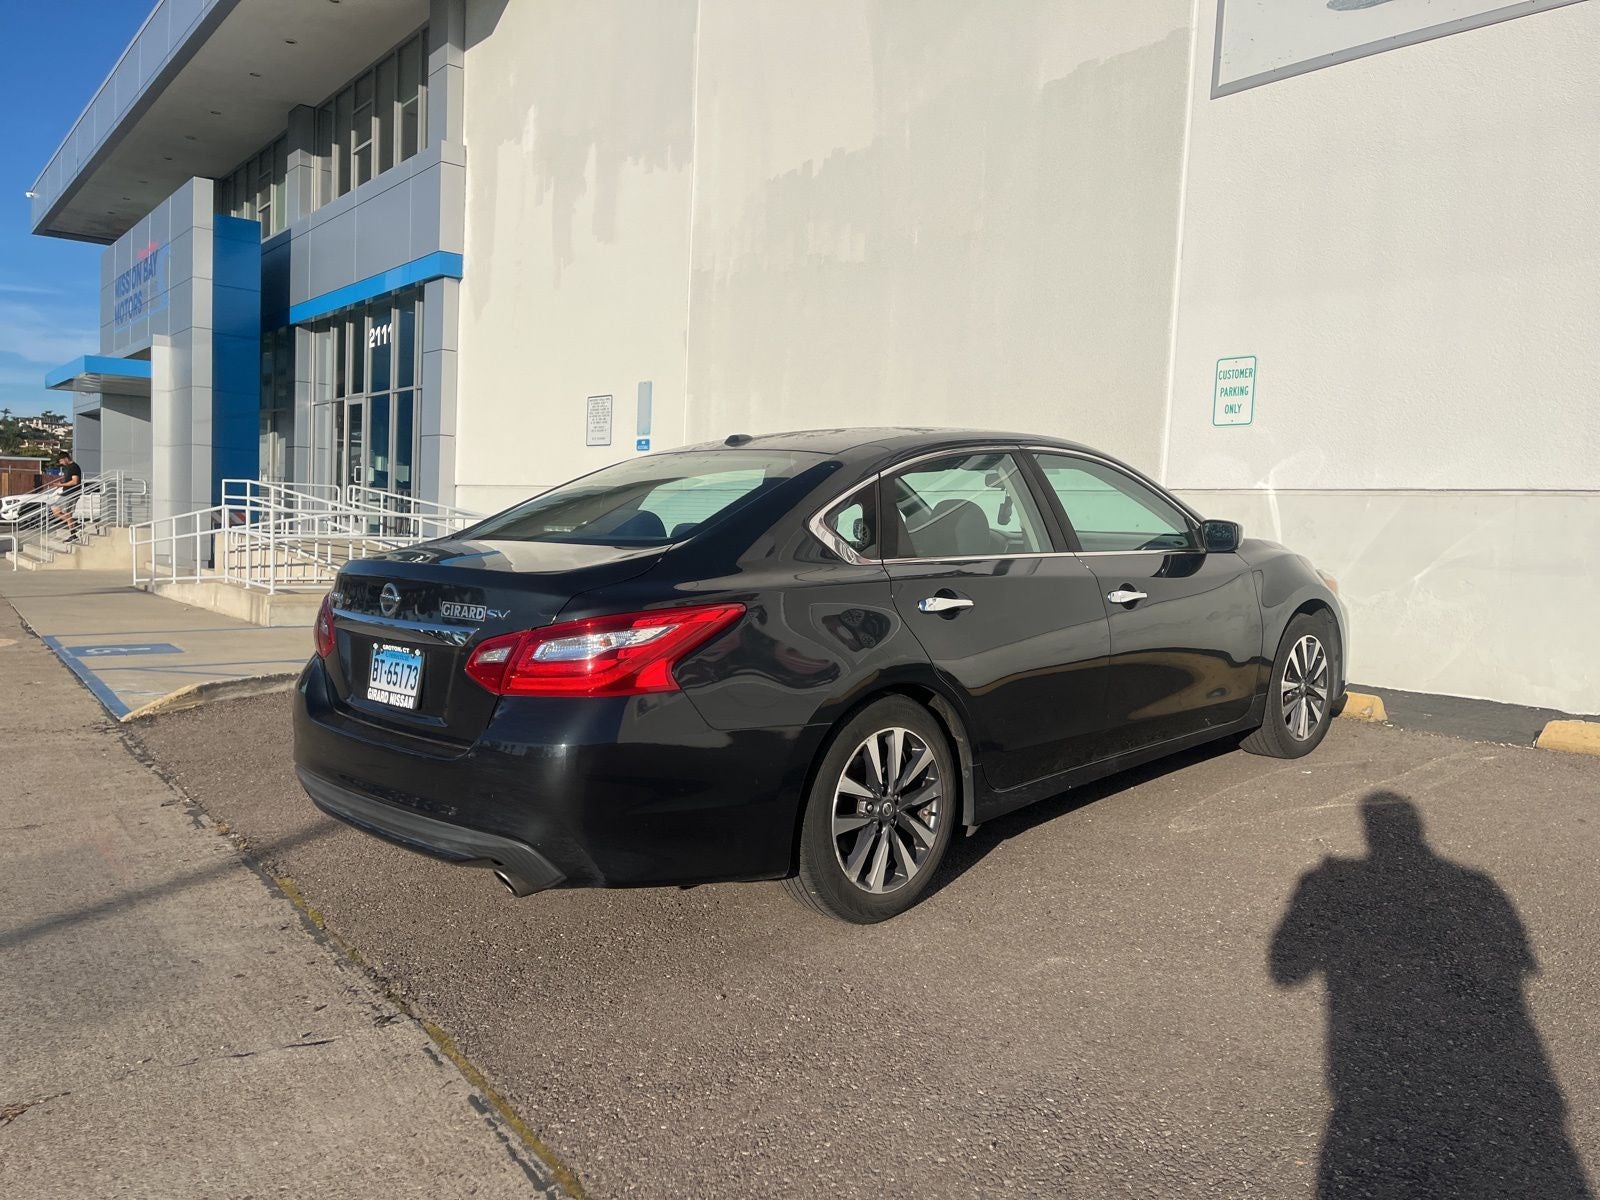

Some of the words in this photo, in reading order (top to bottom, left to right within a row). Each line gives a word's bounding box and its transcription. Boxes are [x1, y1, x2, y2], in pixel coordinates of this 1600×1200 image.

[143, 249, 159, 282] BAY
[1218, 367, 1254, 380] CUSTOMER
[1220, 385, 1249, 397] PARKING
[1224, 403, 1242, 414] ONLY
[443, 604, 484, 619] GIRARD
[486, 609, 511, 619] SV
[367, 687, 389, 703] GIRARD
[389, 692, 415, 709] NISSAN
